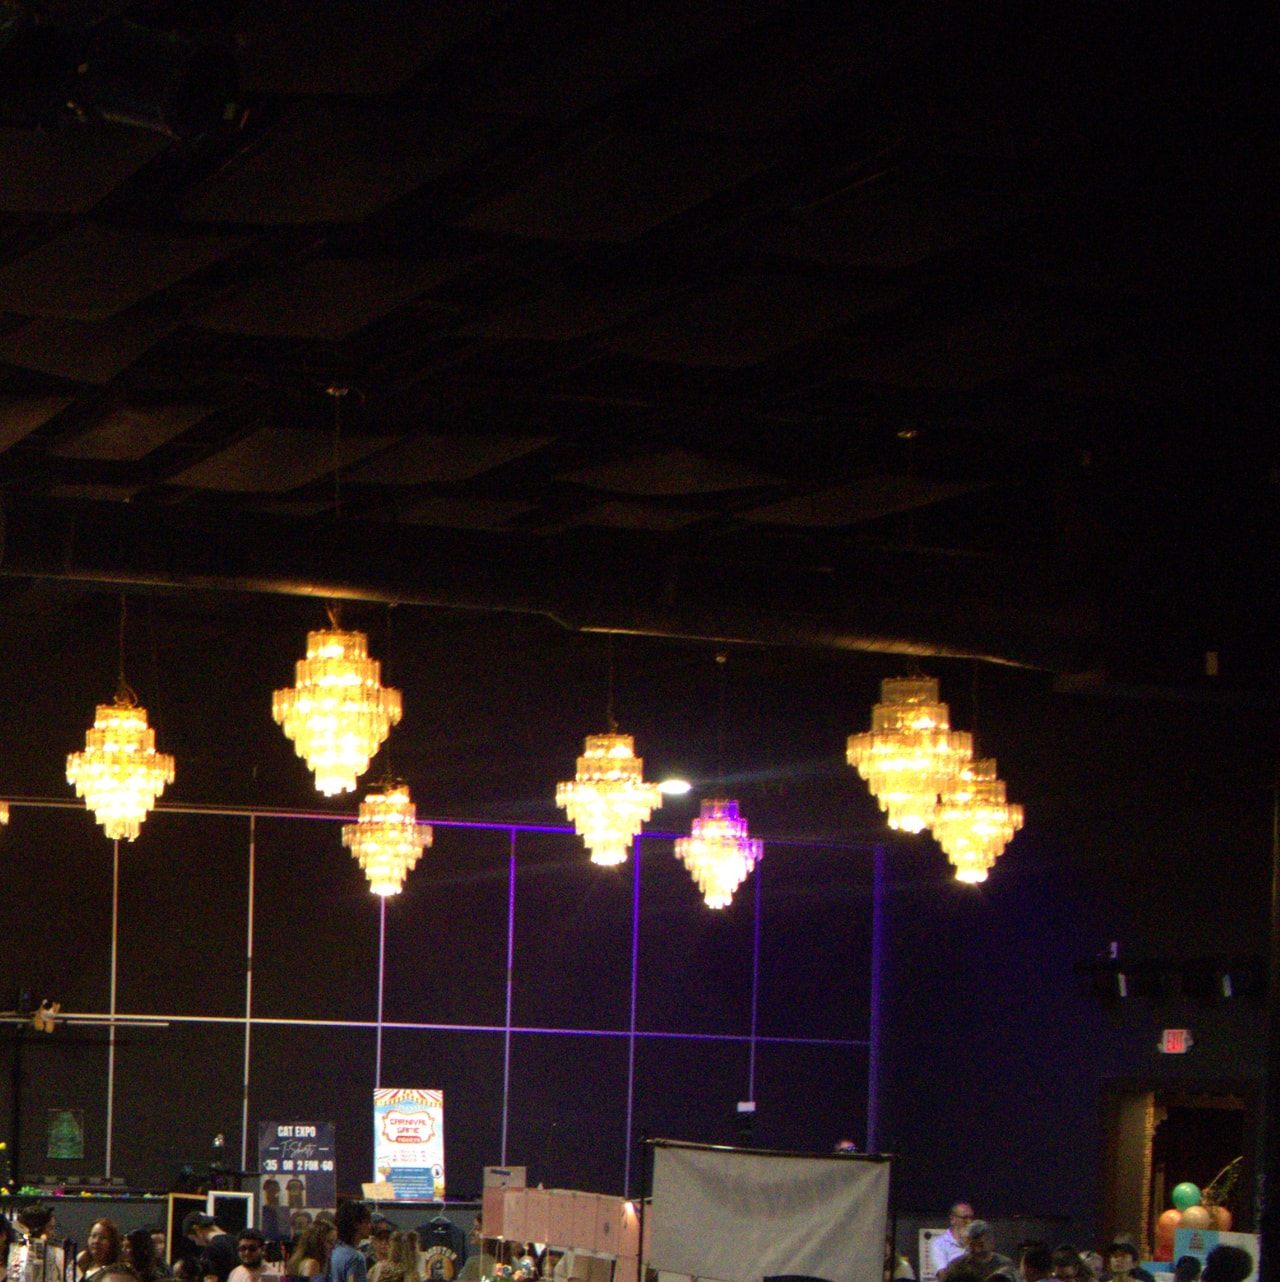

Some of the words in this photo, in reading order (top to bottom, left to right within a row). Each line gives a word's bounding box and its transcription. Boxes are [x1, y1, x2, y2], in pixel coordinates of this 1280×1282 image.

[1167, 1030, 1185, 1051] EXIT
[277, 1125, 294, 1137] CAT
[294, 1125, 317, 1138] EXPO
[282, 1159, 294, 1171] OR
[296, 1159, 303, 1171] 2
[303, 1159, 320, 1171] FOR
